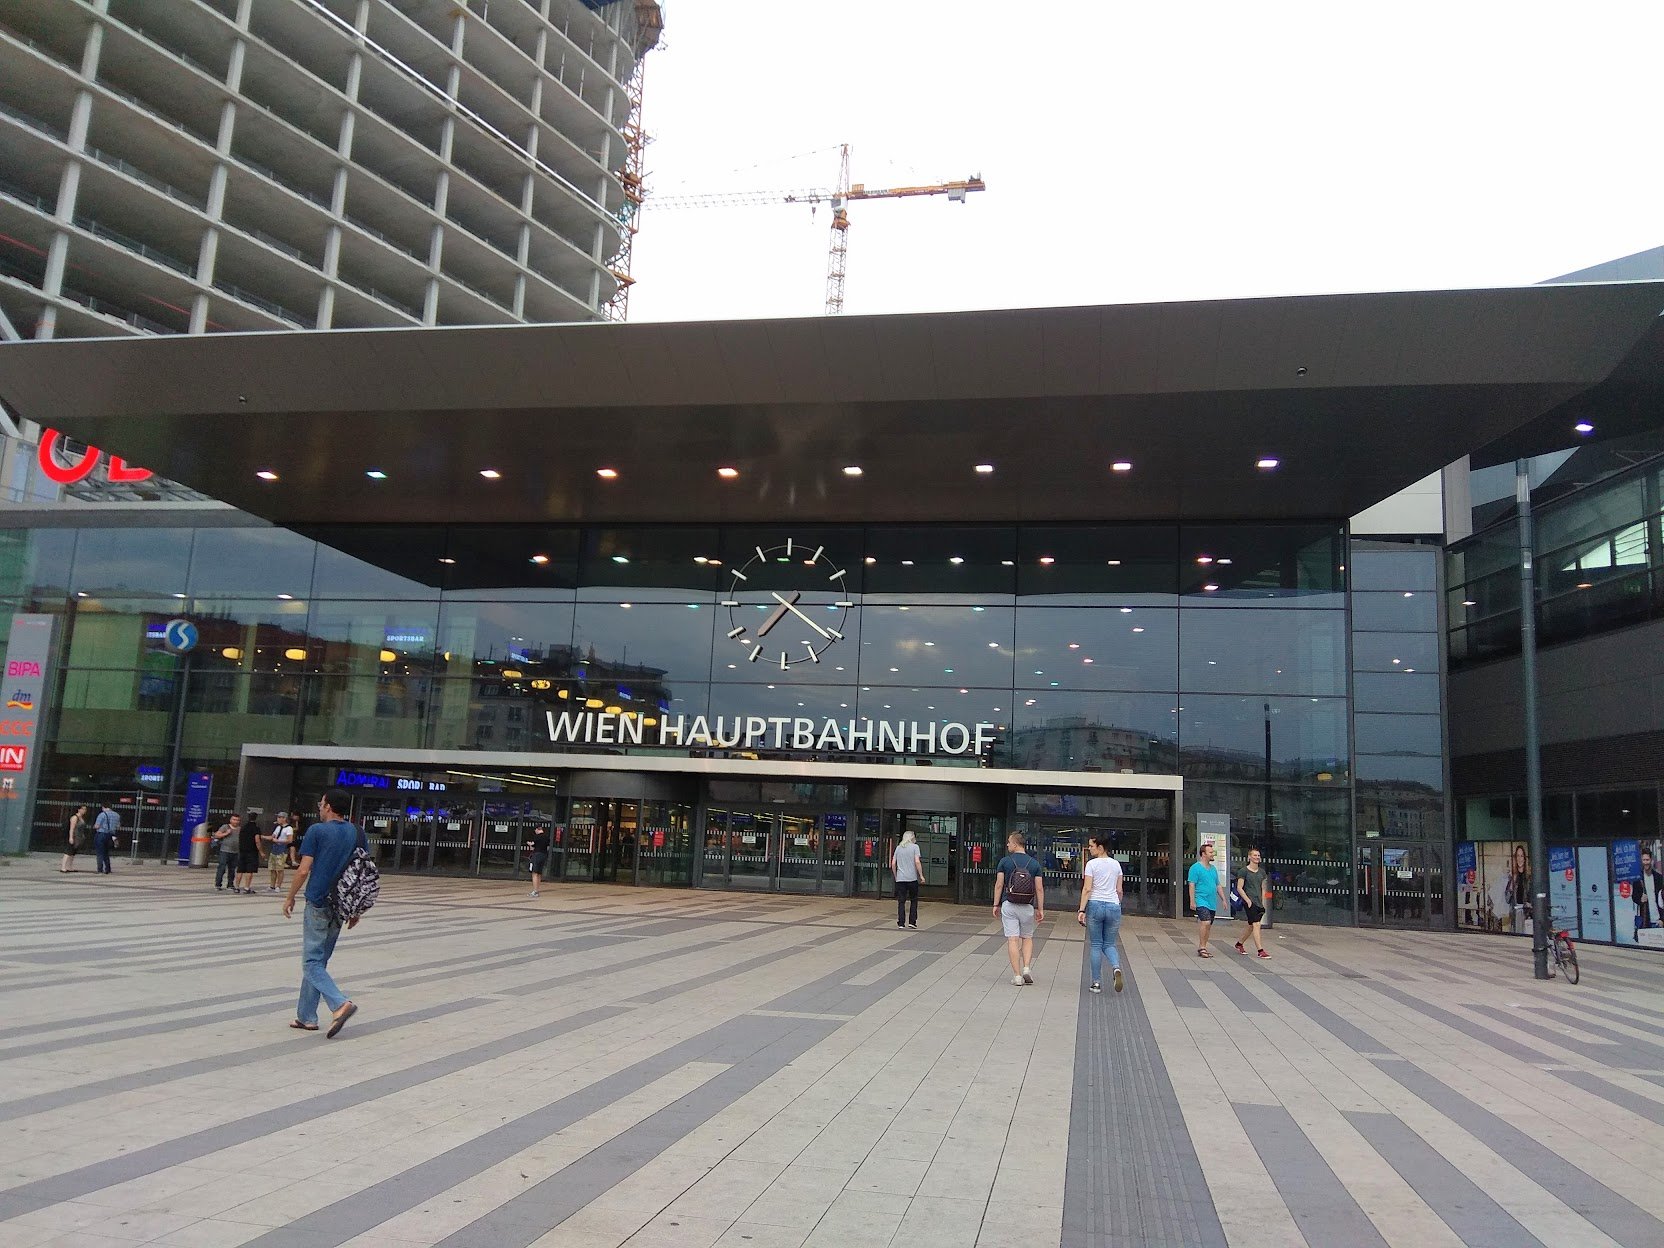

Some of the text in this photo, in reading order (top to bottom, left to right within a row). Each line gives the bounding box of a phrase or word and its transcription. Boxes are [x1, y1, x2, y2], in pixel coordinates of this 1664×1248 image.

[8, 661, 41, 677] BIPA
[12, 689, 31, 702] dm
[0, 720, 33, 736] CCC
[546, 711, 995, 755] WIEN HAUPTBAHNHOF
